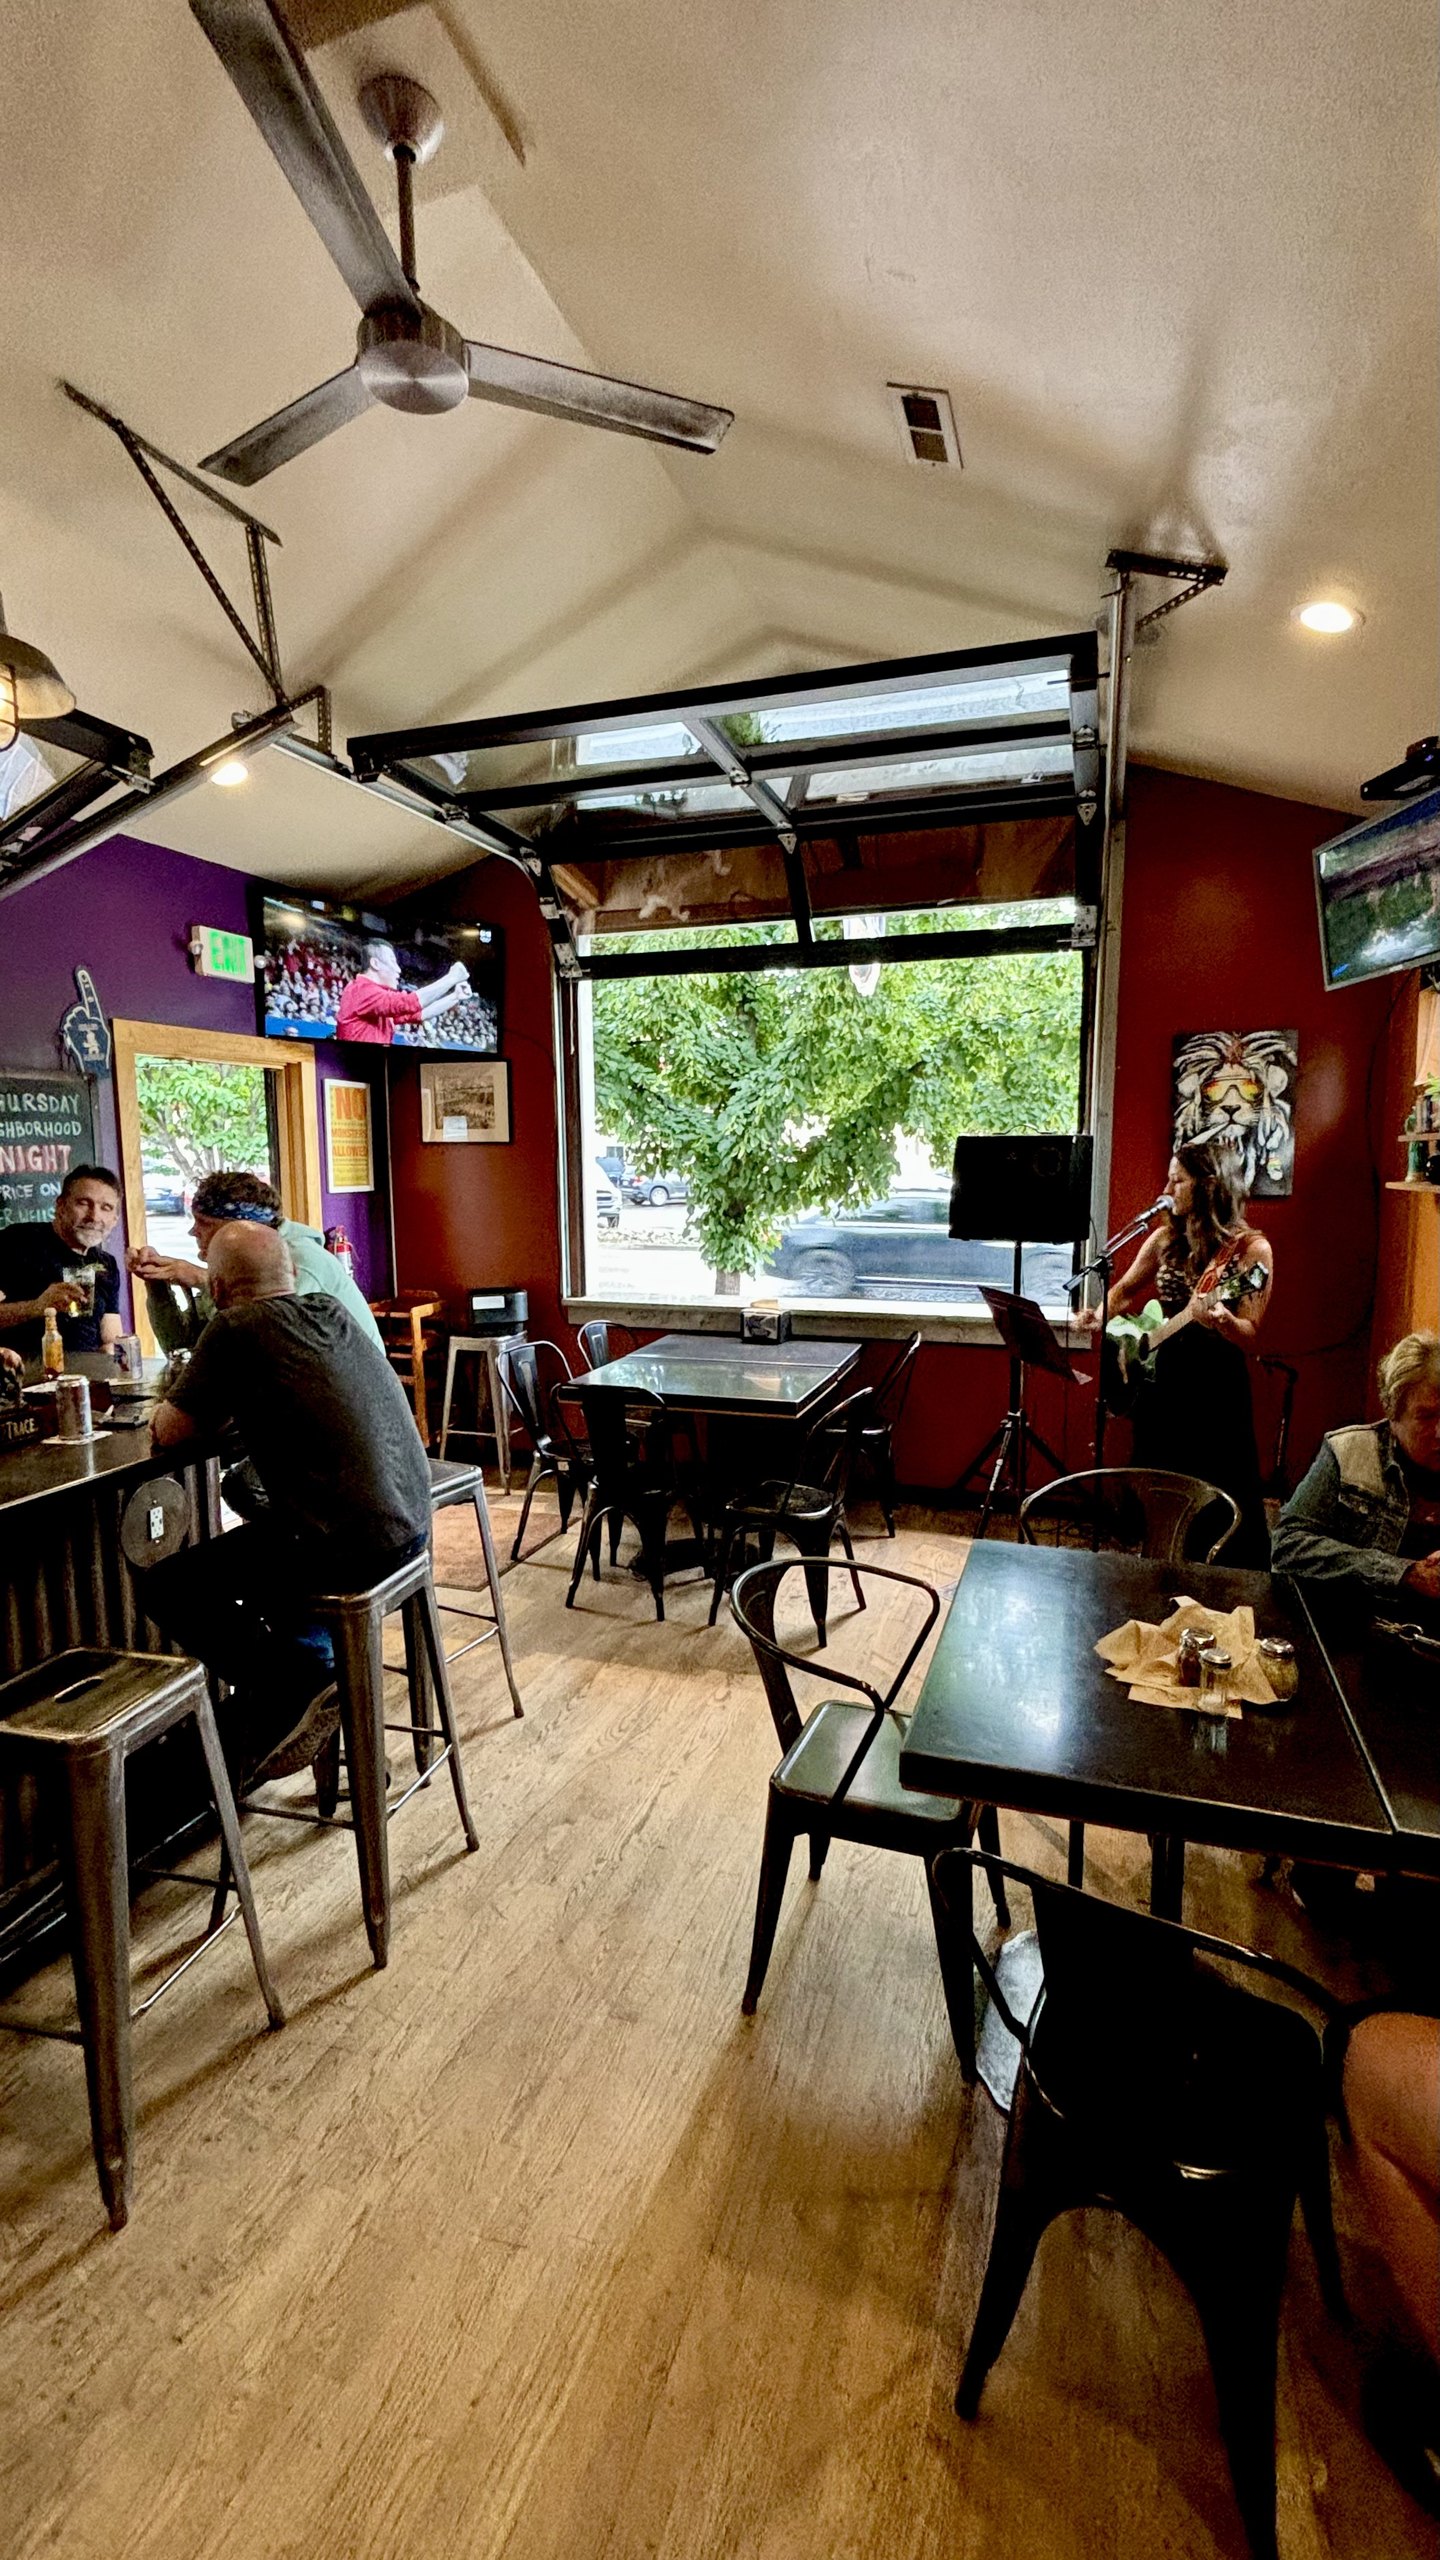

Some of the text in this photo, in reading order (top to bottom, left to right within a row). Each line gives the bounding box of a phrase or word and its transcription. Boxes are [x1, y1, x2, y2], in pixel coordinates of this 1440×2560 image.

[209, 930, 247, 976] EXIT
[335, 1087, 367, 1120] NO
[0, 1144, 71, 1173] NIGHT
[0, 1184, 34, 1200] RICE
